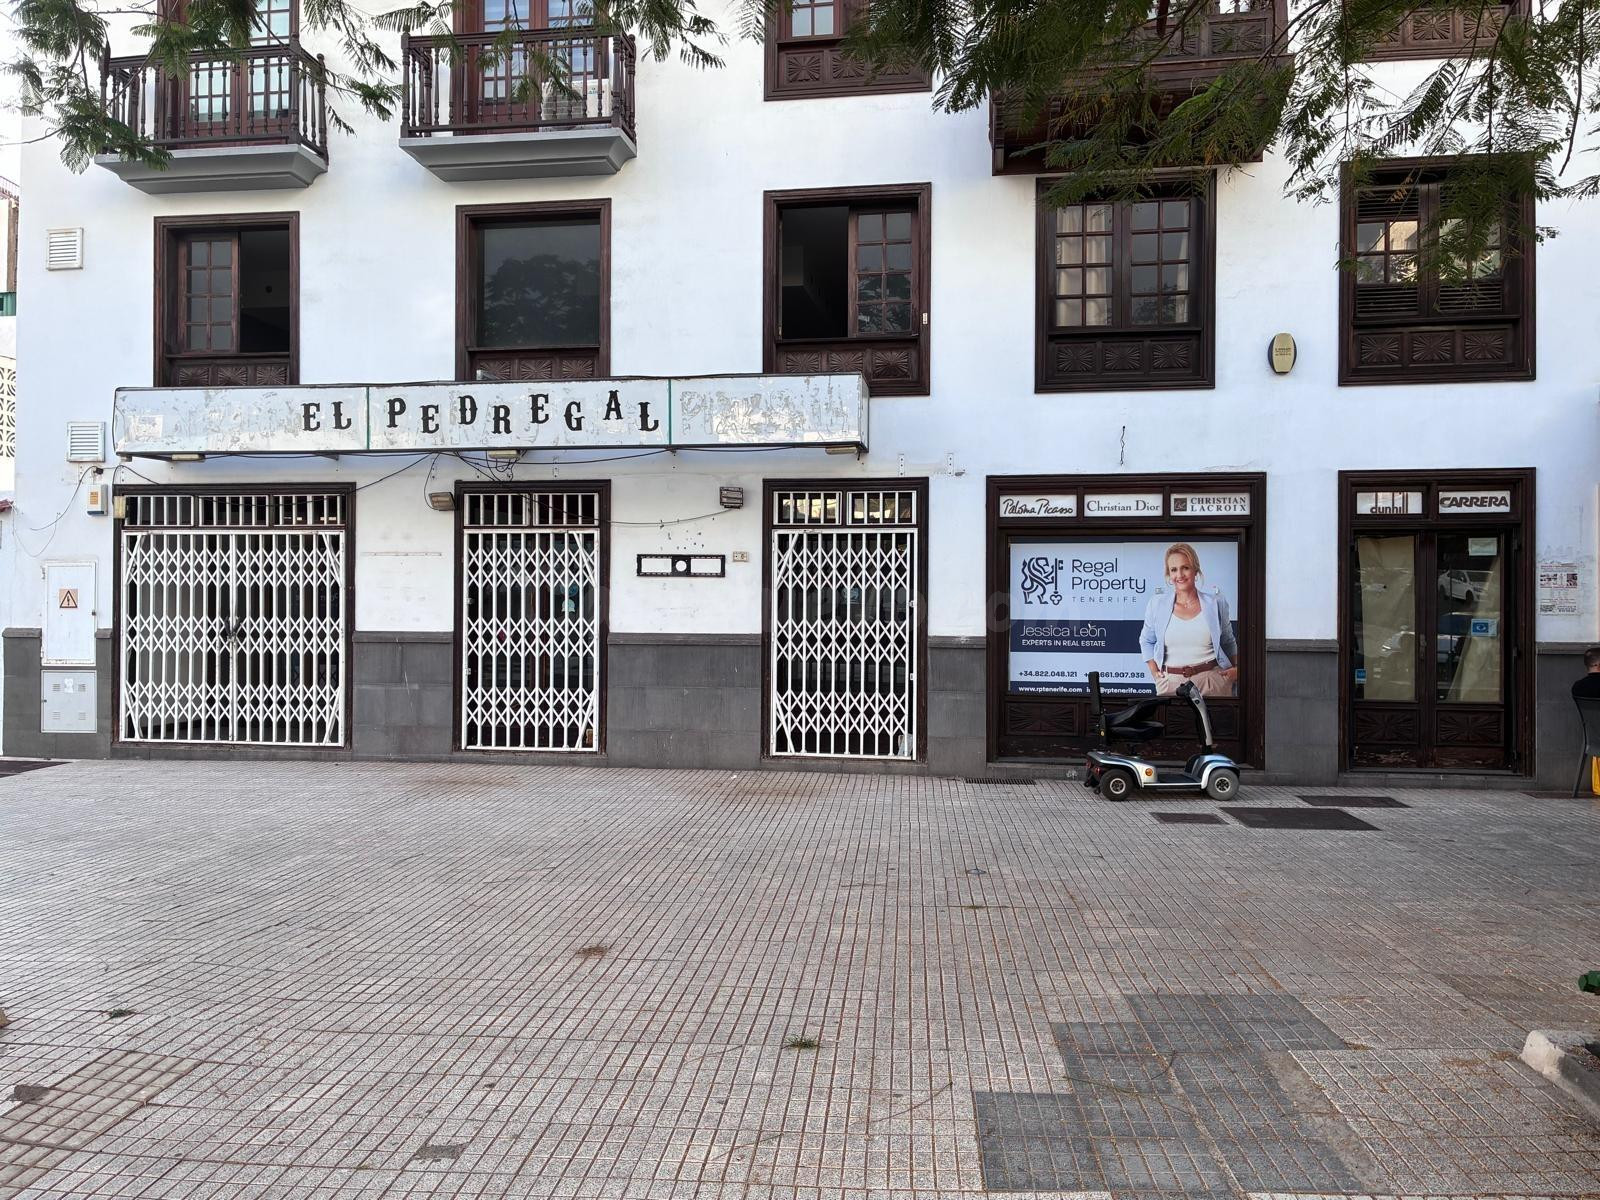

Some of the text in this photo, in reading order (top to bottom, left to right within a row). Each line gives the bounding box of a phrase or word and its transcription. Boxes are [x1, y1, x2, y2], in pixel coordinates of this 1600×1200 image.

[302, 390, 660, 434] EL PEDREGAL
[1003, 498, 1074, 515] Paloma Picasso
[1086, 500, 1160, 512] Christian Dior
[1190, 504, 1246, 512] LACROIX
[1439, 496, 1509, 508] CARRERA
[1071, 557, 1118, 577] Regal
[1071, 576, 1146, 593] Property
[1020, 623, 1107, 637] Jessica León
[1083, 671, 1145, 679] +.661.907.938
[1018, 686, 1083, 694] www.rptenerife.com
